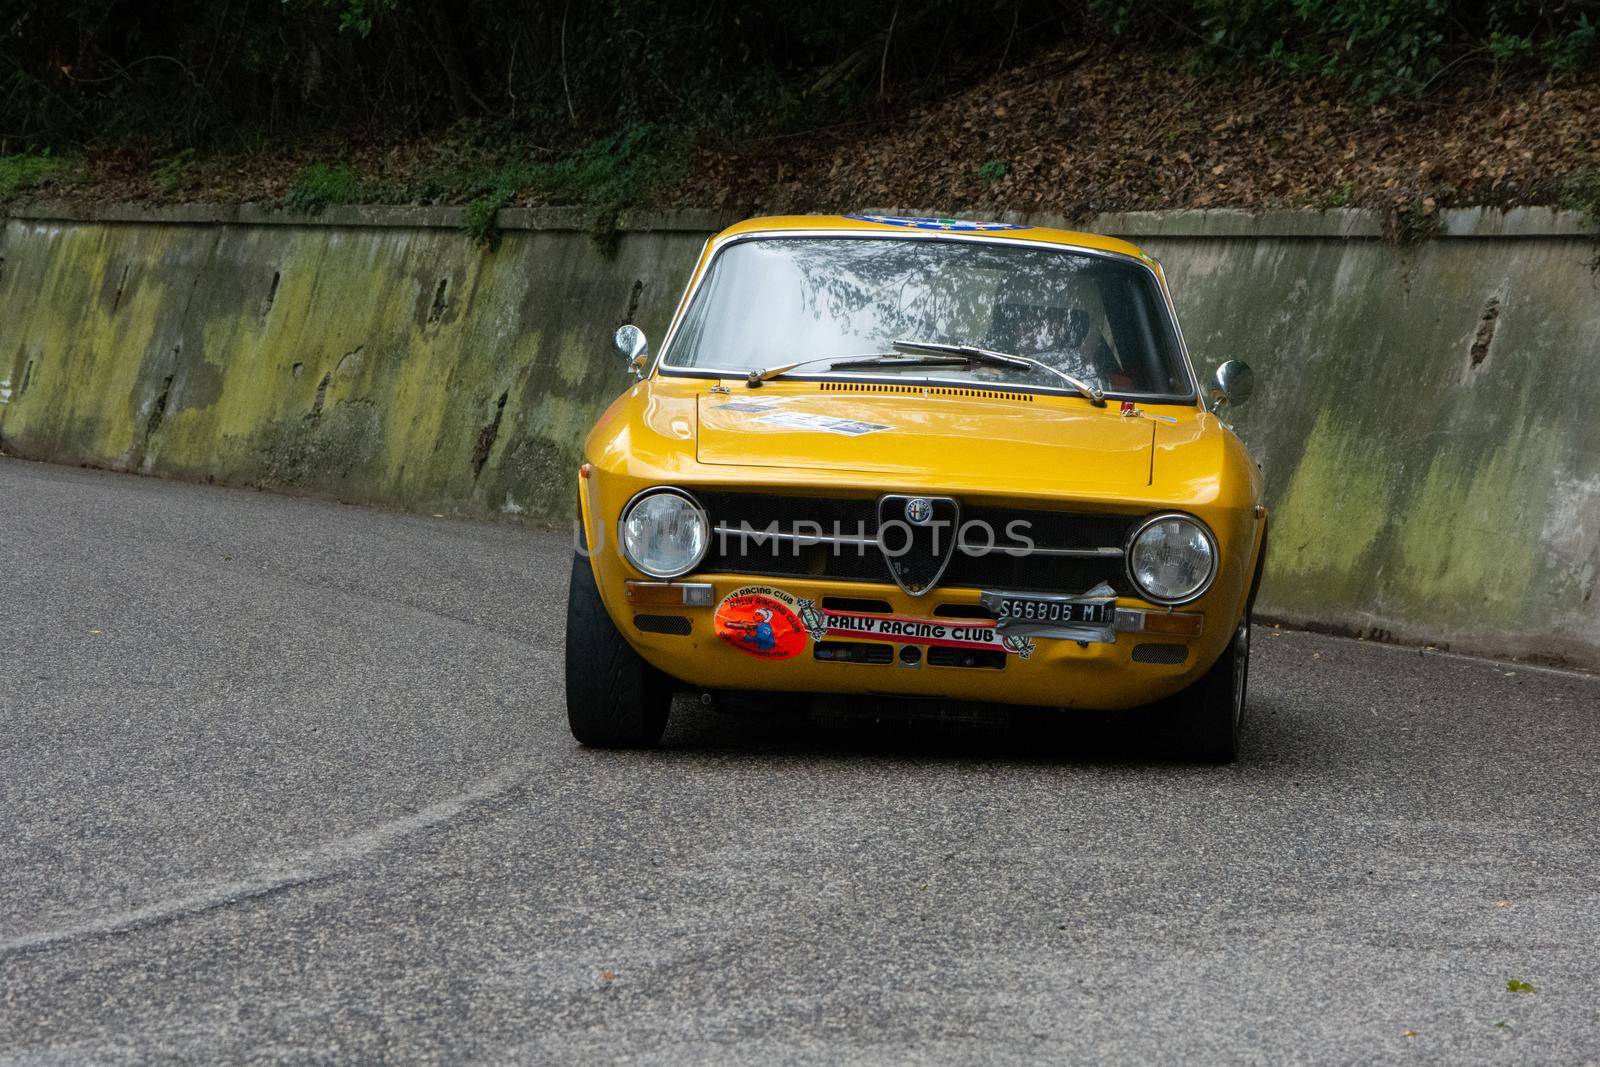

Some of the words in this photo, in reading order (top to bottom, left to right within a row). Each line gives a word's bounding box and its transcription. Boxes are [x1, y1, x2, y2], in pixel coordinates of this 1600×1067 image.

[739, 587, 772, 597] RACING
[773, 590, 794, 604] CLUB
[730, 598, 754, 609] RALLY
[756, 598, 787, 615] RACING
[786, 615, 801, 633] CLUB
[1000, 600, 1073, 621] S66806
[826, 615, 875, 632] RALLY
[879, 621, 946, 638] RACING
[951, 627, 994, 642] CLUB
